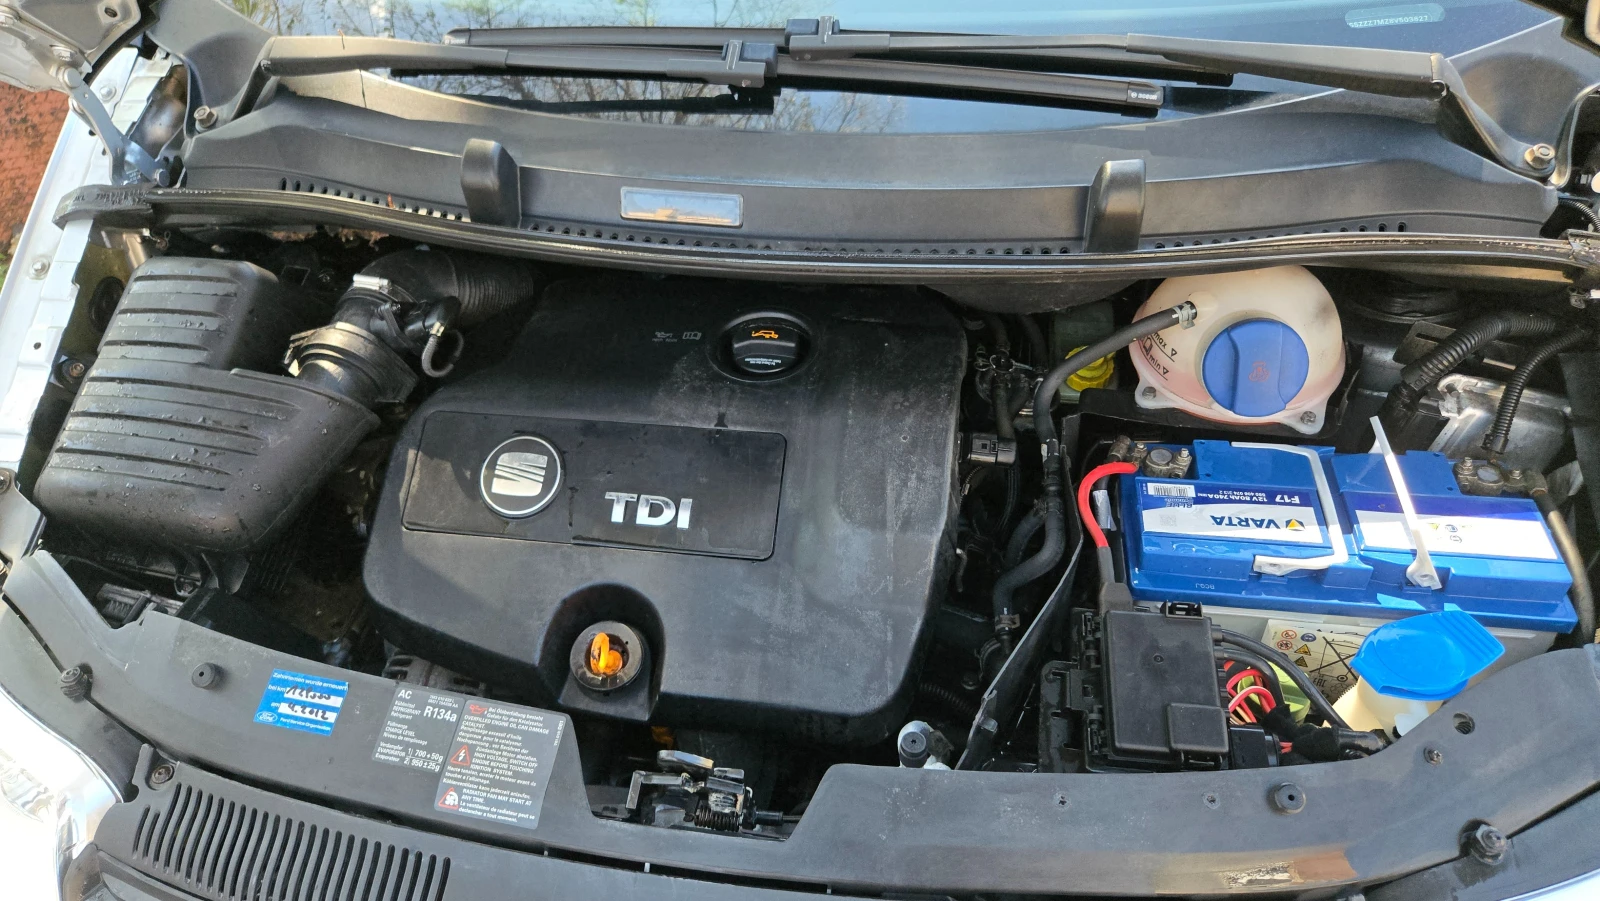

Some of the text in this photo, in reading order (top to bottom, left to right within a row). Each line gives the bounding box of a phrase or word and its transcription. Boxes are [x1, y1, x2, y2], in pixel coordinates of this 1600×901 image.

[1154, 332, 1167, 349] max
[1149, 355, 1161, 370] min
[1275, 495, 1300, 504] F17
[605, 492, 692, 529] TDI
[1210, 515, 1281, 529] VARTA
[398, 690, 412, 699] AC
[424, 706, 457, 722] R134a
[463, 788, 487, 796] RADIATOR
